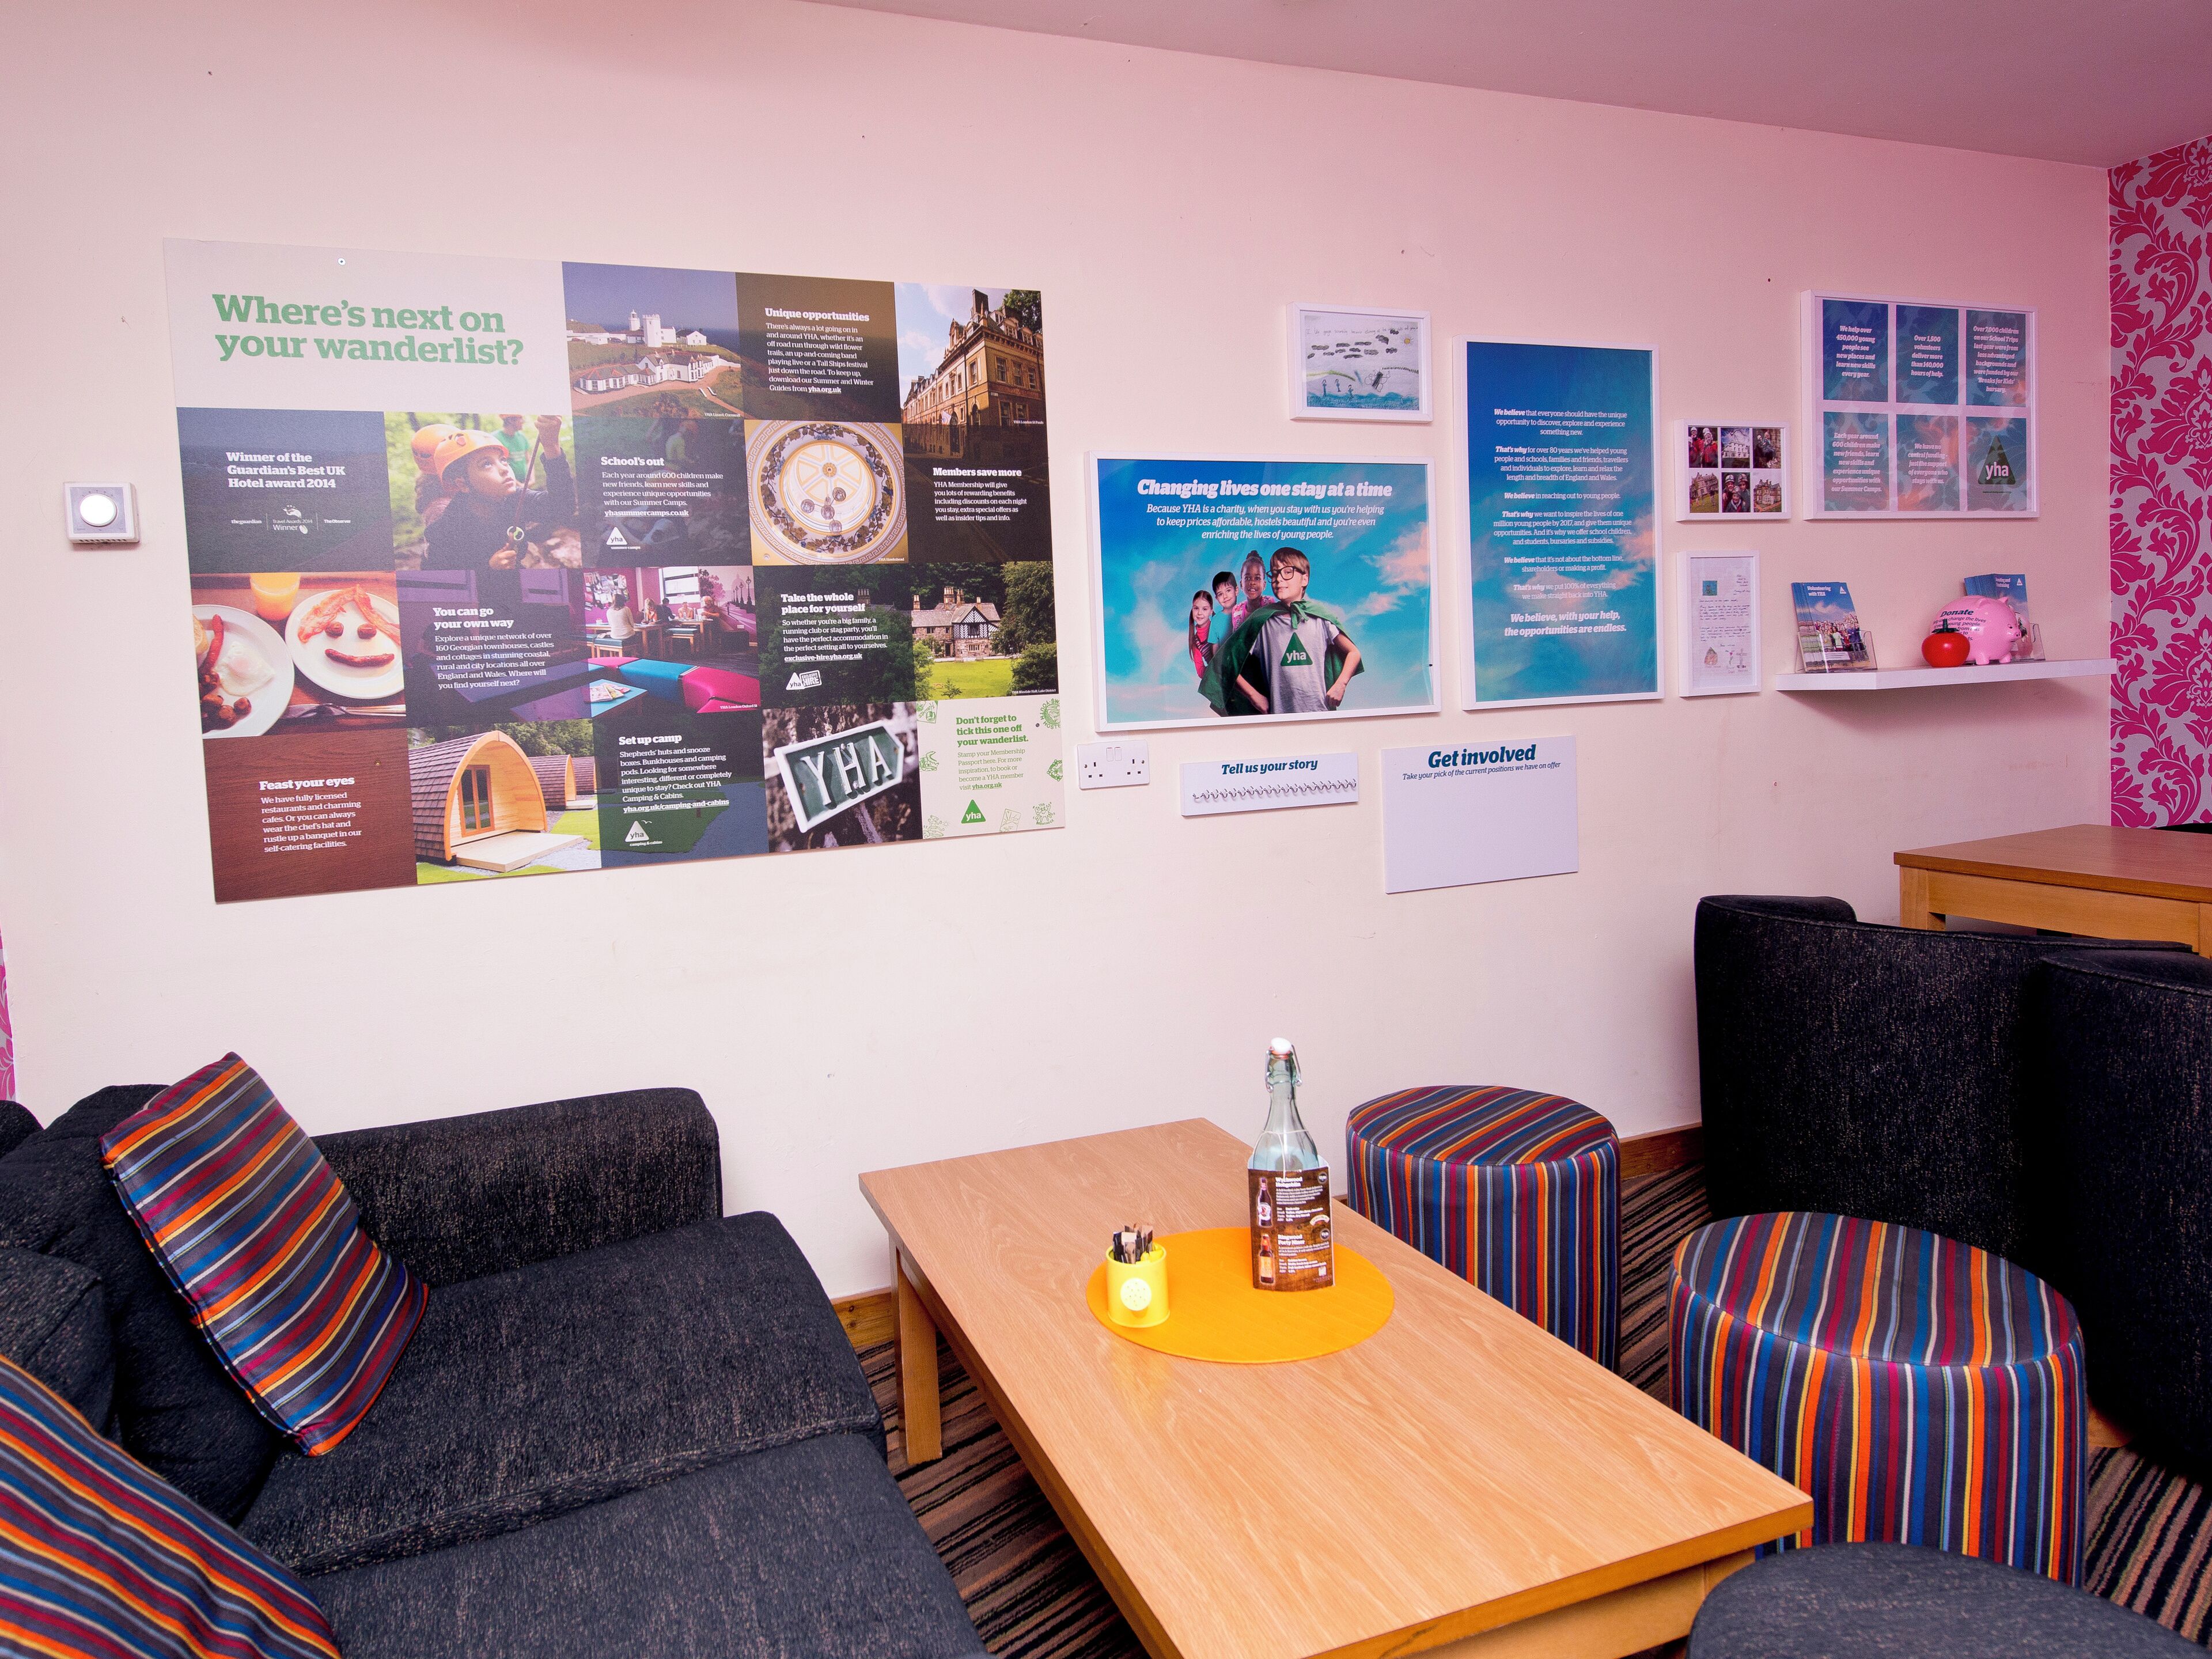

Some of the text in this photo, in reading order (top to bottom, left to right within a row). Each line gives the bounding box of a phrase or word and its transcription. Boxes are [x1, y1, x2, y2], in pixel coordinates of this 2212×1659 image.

[212, 295, 505, 332] Where's next on
[765, 308, 870, 321] Unique opportunities
[215, 334, 523, 365] your wanderlist?
[808, 386, 842, 394] yha.org.uk
[226, 452, 312, 462] Winner of the
[601, 456, 665, 466] School's out
[227, 465, 346, 475] Guardian's Best UK
[933, 468, 976, 476] Members
[1986, 462, 2009, 479] yha
[228, 478, 336, 488] Hotel award 2014
[1138, 480, 1392, 499] Changing lives one stay at a time
[1147, 504, 1180, 513] Because
[1182, 504, 1200, 513] YHA
[1202, 504, 1209, 513] is
[1216, 505, 1246, 515] charity,
[1248, 505, 1269, 513] when
[1270, 506, 1285, 516] you
[1286, 505, 1302, 516] stay
[1304, 505, 1320, 513] with
[1332, 505, 1355, 516] you're
[1357, 505, 1384, 516] helping
[781, 592, 854, 603] Take the whole
[433, 607, 456, 616] You
[479, 608, 494, 617] go
[781, 603, 865, 615] place for yourself
[1511, 610, 1620, 623] We believe, with your help,
[433, 621, 462, 630] your
[490, 620, 514, 628] way
[1505, 627, 1518, 637] the
[1520, 626, 1577, 637] opportunities
[1594, 623, 1627, 632] endless.
[784, 653, 862, 662] exclusive-hire.yha.org.uk
[1286, 650, 1306, 663] yha
[802, 677, 819, 686] HIRE
[956, 717, 980, 725] Don't
[980, 715, 1007, 724] forget
[956, 728, 974, 736] tick
[975, 726, 992, 734] this
[1010, 724, 1022, 732] off
[619, 735, 682, 745] Set up camp
[957, 735, 1029, 748] your wanderlist.
[1429, 744, 1536, 768] Get involved
[800, 736, 892, 805] YHA
[1222, 760, 1318, 775] Tell us your story
[1433, 770, 1447, 779] pick
[1487, 765, 1514, 774] positions
[1547, 762, 1561, 770] offer
[259, 777, 355, 790] Feast your eyes
[972, 782, 1002, 790] yha.org.uk
[315, 791, 347, 800] licensed
[623, 799, 729, 813] yha.org.uk/camping-and-cabins
[966, 812, 982, 821] yha
